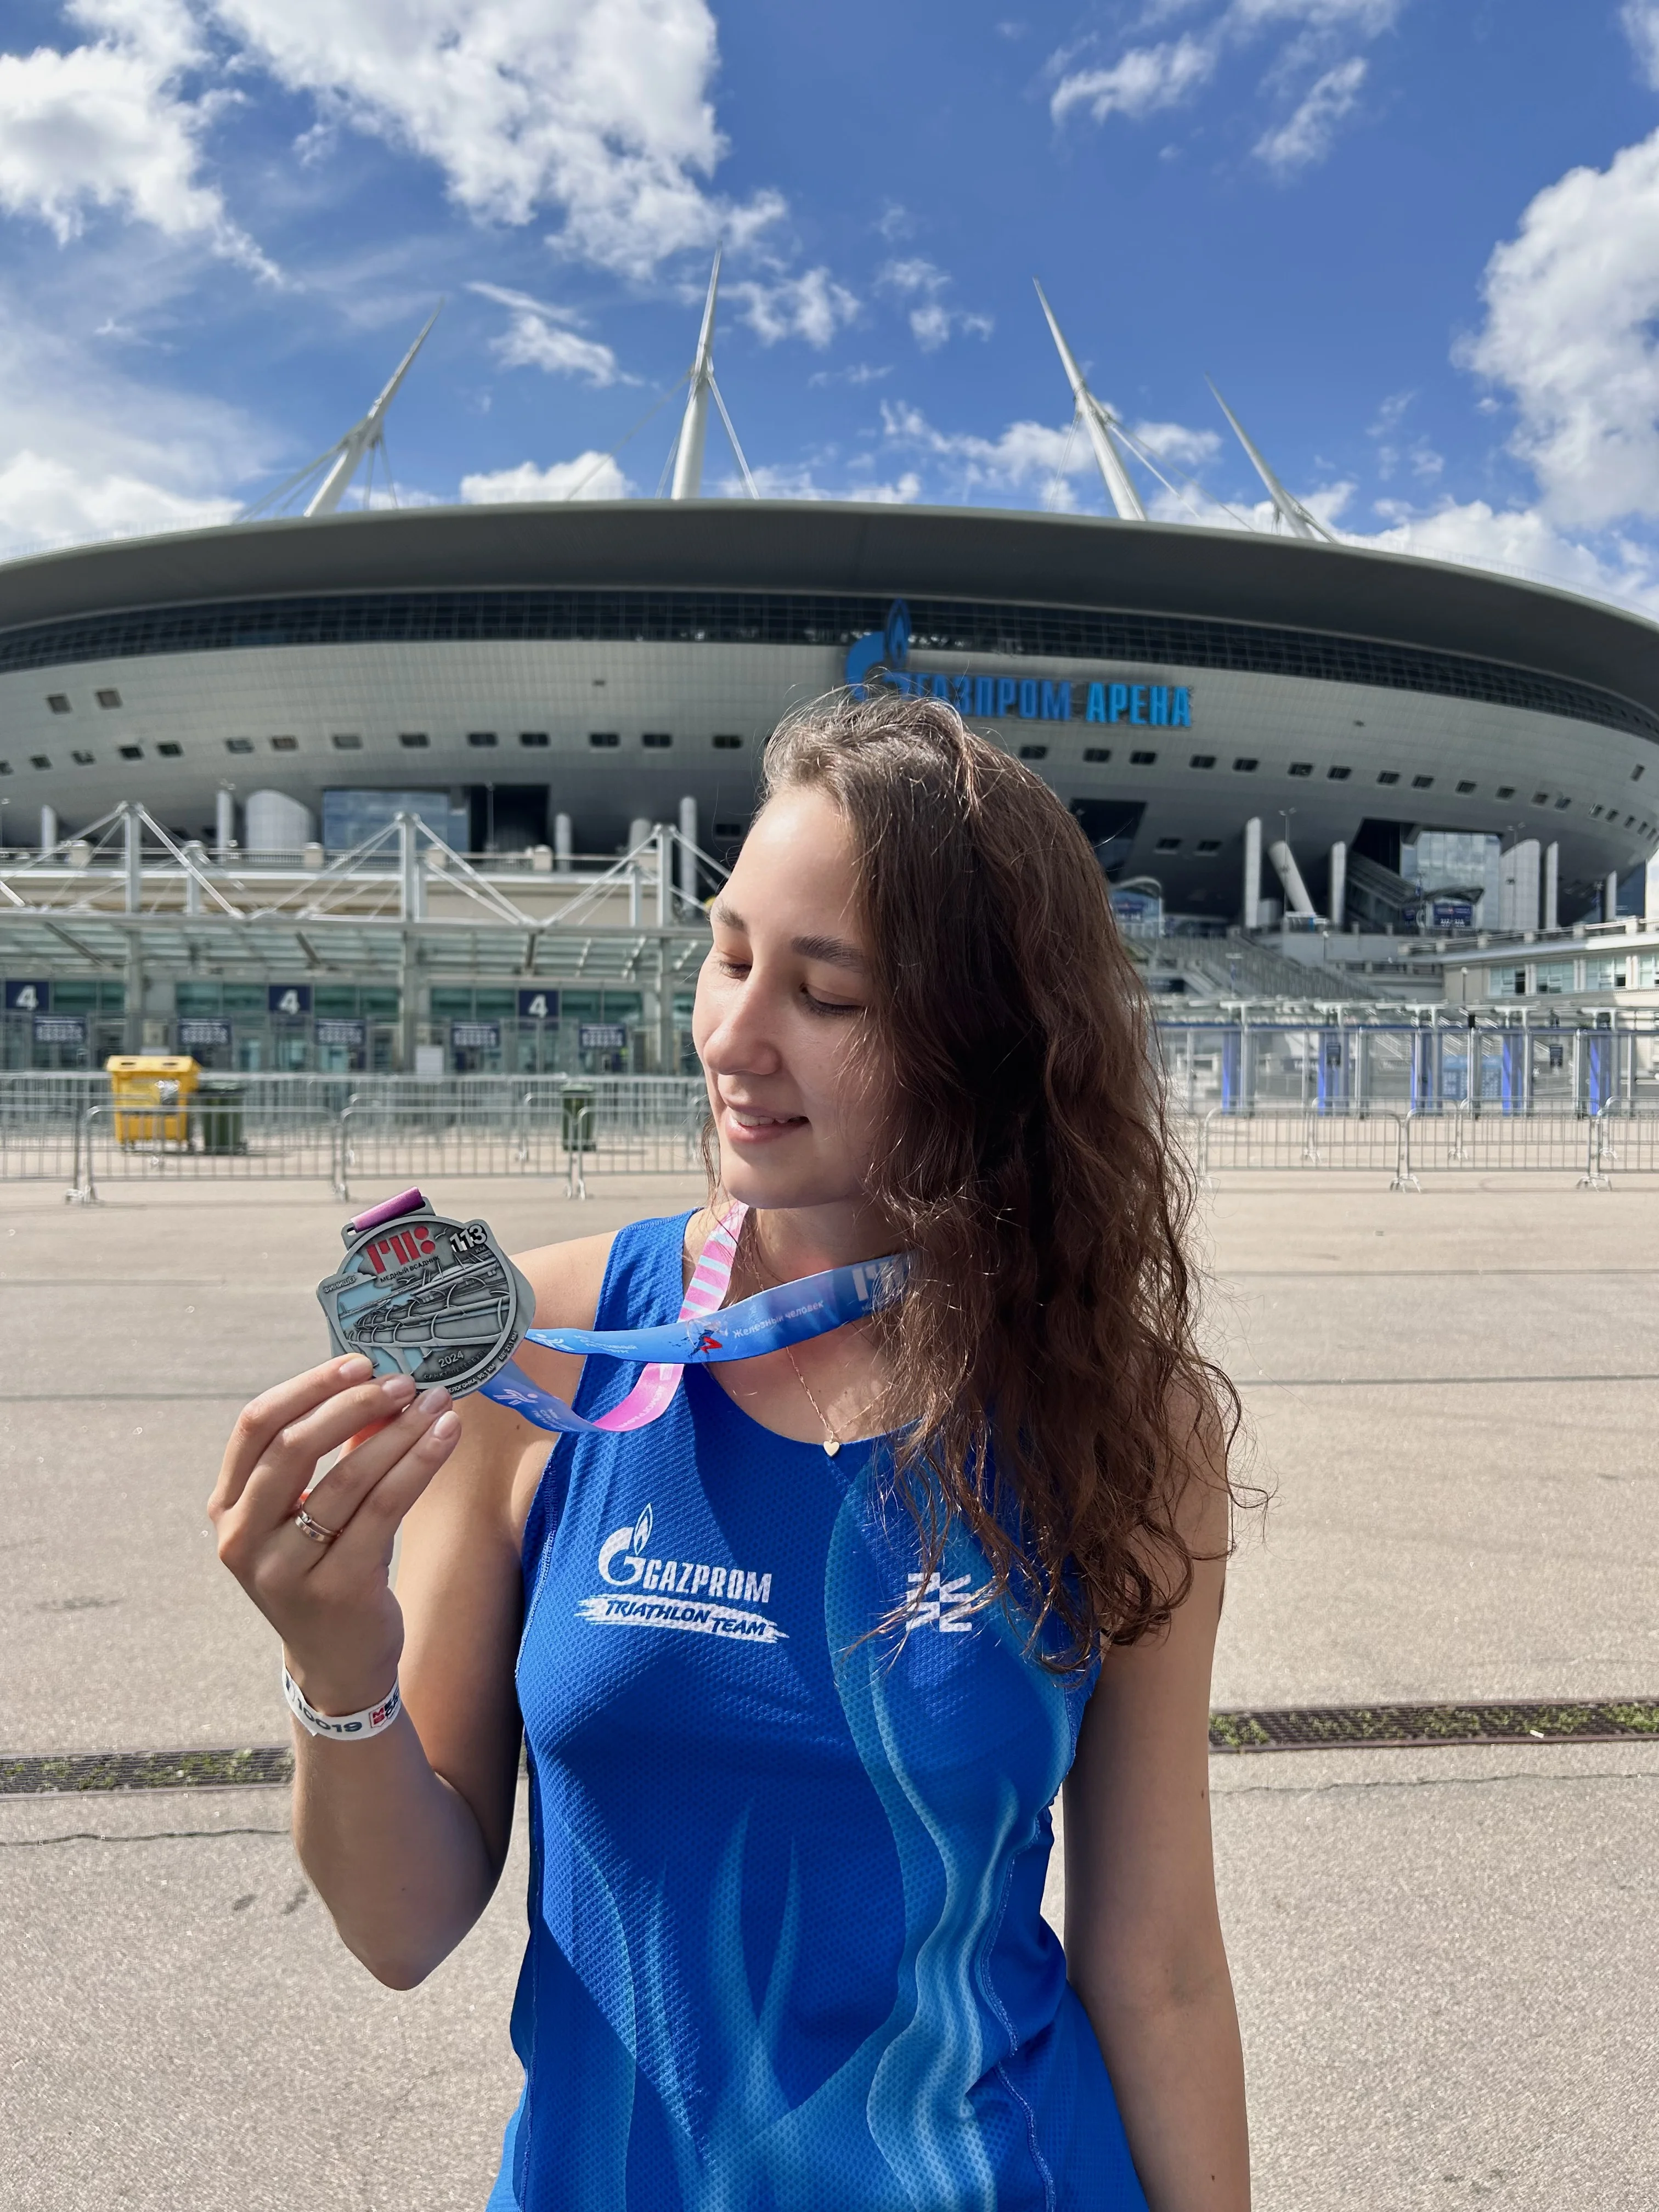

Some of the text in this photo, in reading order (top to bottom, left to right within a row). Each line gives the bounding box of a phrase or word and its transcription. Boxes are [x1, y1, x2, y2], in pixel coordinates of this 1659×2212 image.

[1086, 681, 1192, 727] АРЕНА
[16, 985, 38, 1011] 4
[279, 989, 300, 1014] 4
[528, 994, 548, 1018] 4
[450, 1224, 487, 1252] 113
[380, 1255, 440, 1283] МЕДНЫЙ ВСАДНИК
[324, 1275, 357, 1293] ФИНИШЕР
[785, 1300, 824, 1319] человек
[438, 1350, 464, 1368] 2024
[498, 1351, 507, 1361] БЕГ
[511, 1331, 518, 1341] КМ
[448, 1377, 478, 1393] ЕЛОГОНКА
[487, 1363, 496, 1373] КМ
[643, 1558, 772, 1603] GAZPROM
[605, 1600, 766, 1636] TRIATHLON TEAM
